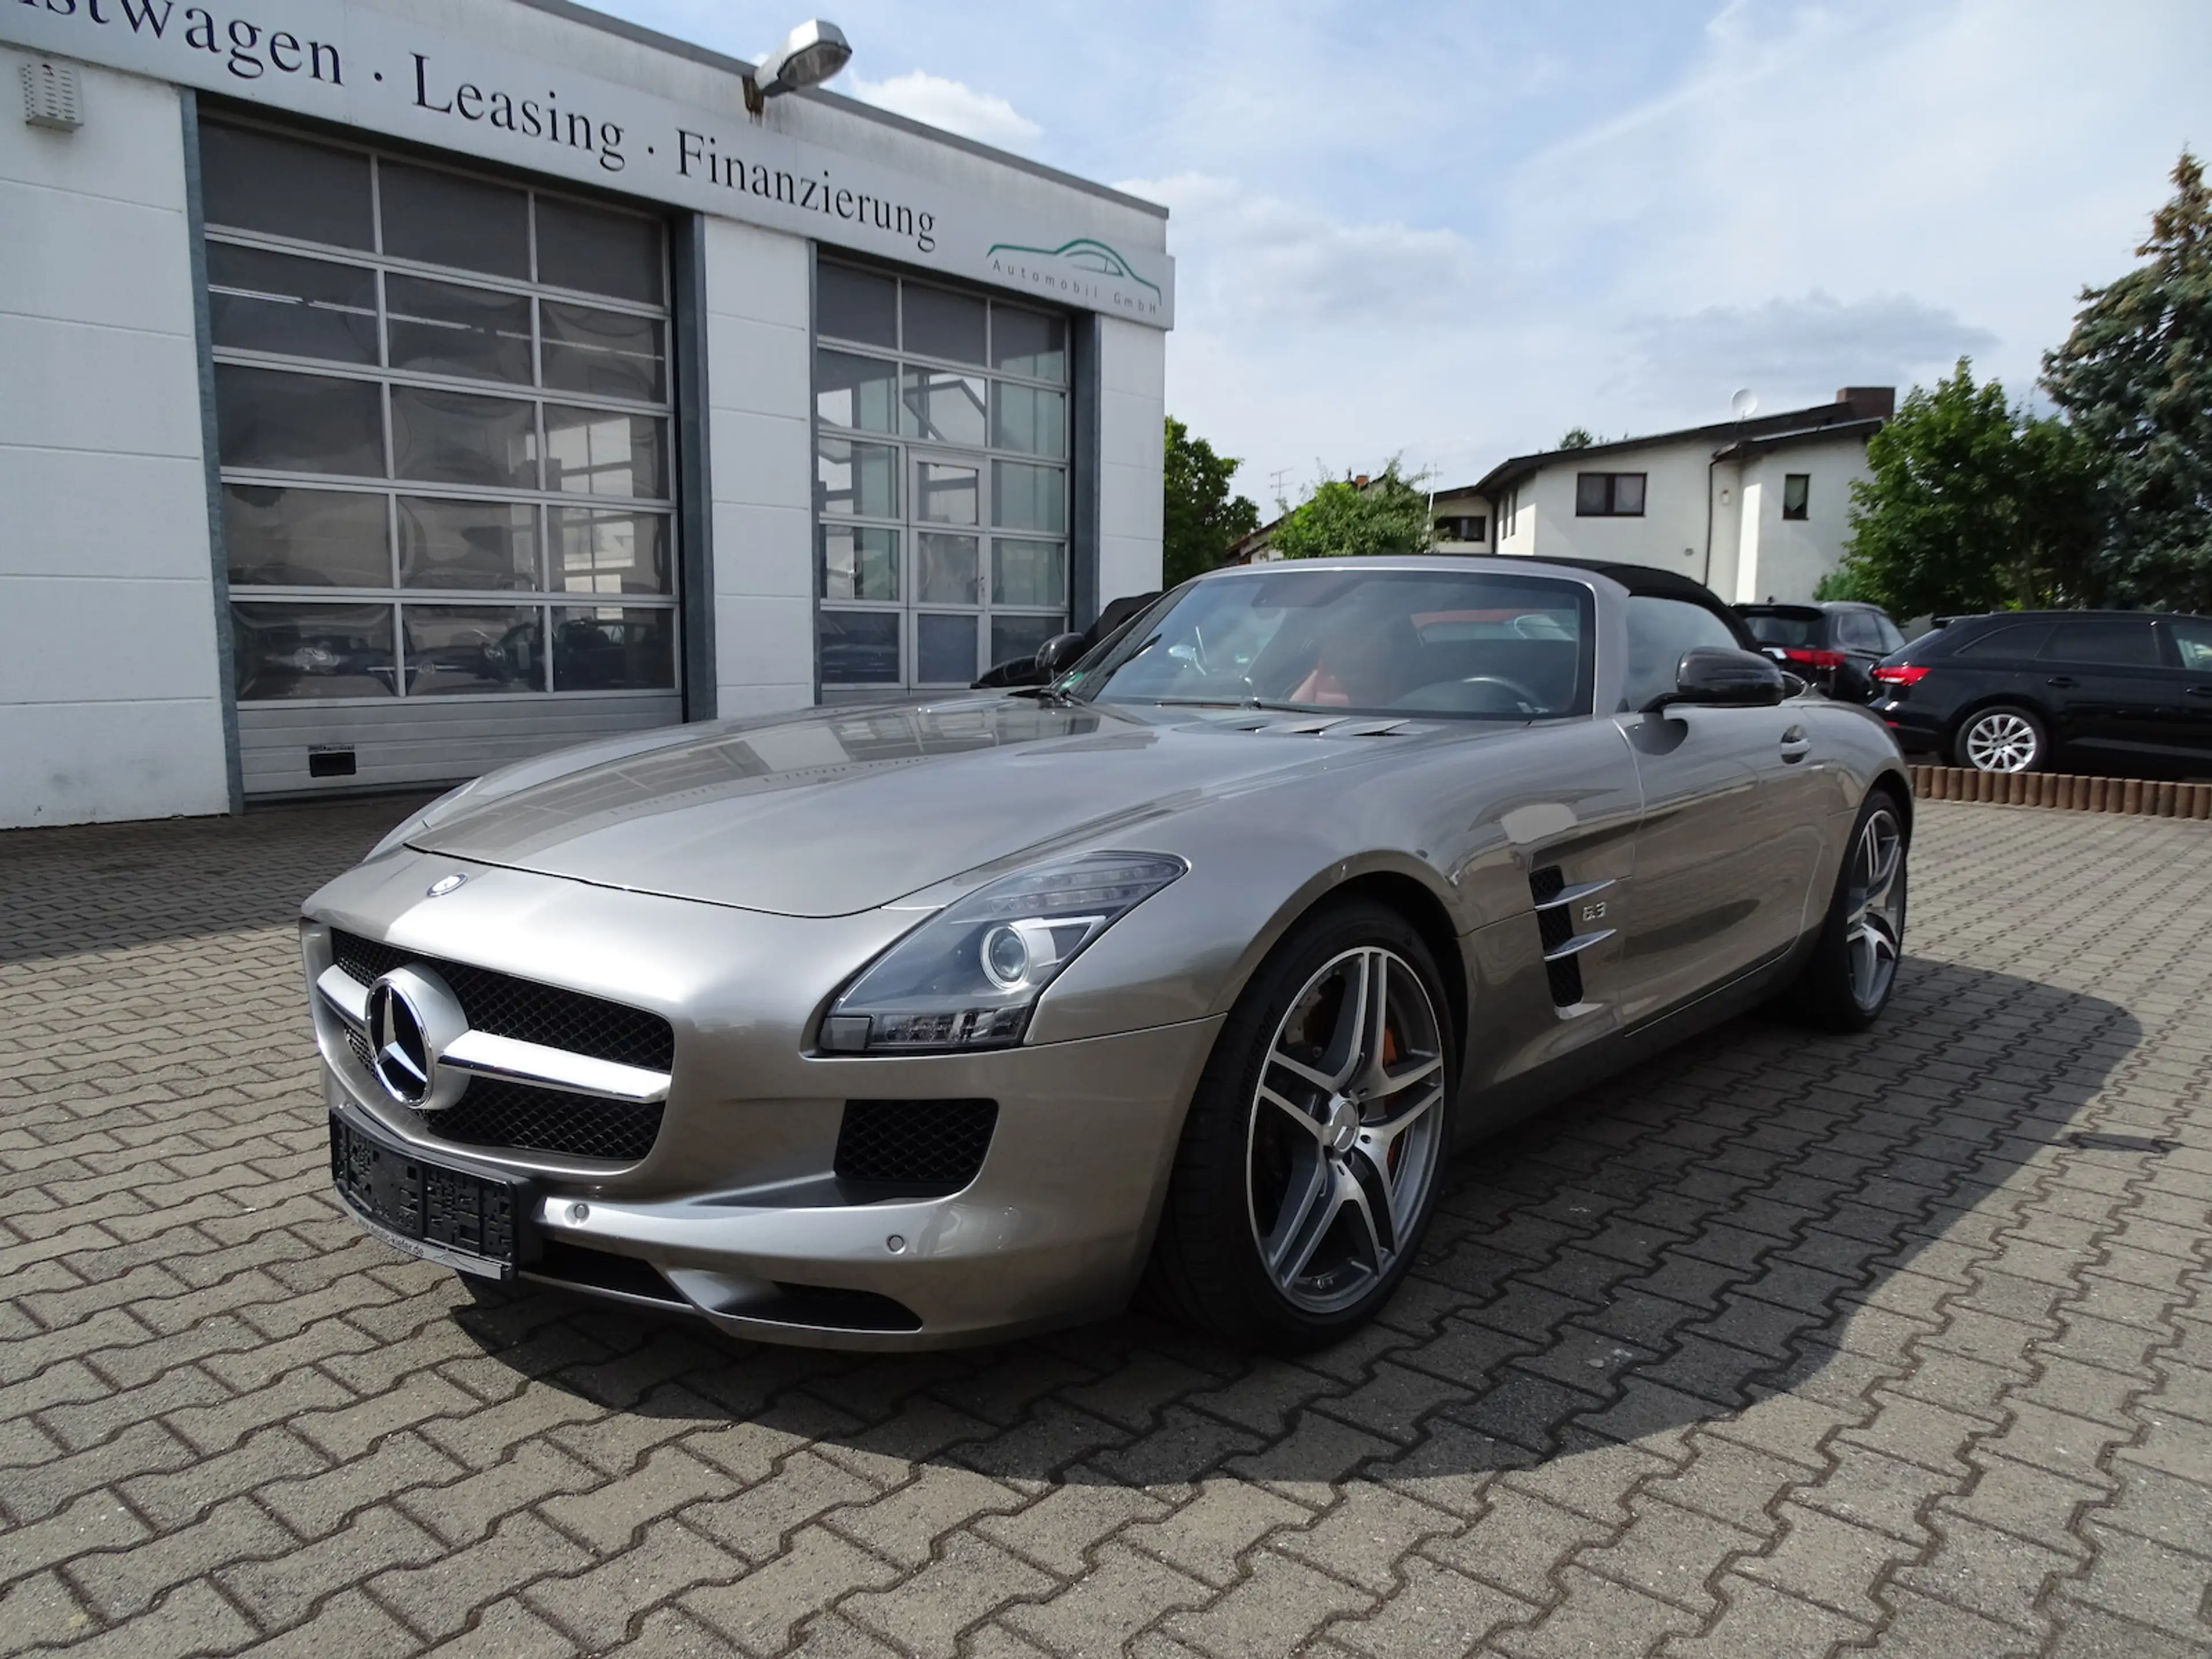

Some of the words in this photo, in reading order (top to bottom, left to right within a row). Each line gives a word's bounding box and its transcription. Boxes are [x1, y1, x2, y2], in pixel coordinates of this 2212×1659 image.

[410, 51, 626, 172] Leasing
[676, 127, 936, 253] Finanzierung
[992, 259, 1097, 299] Automobil
[1113, 293, 1156, 315] GmbH
